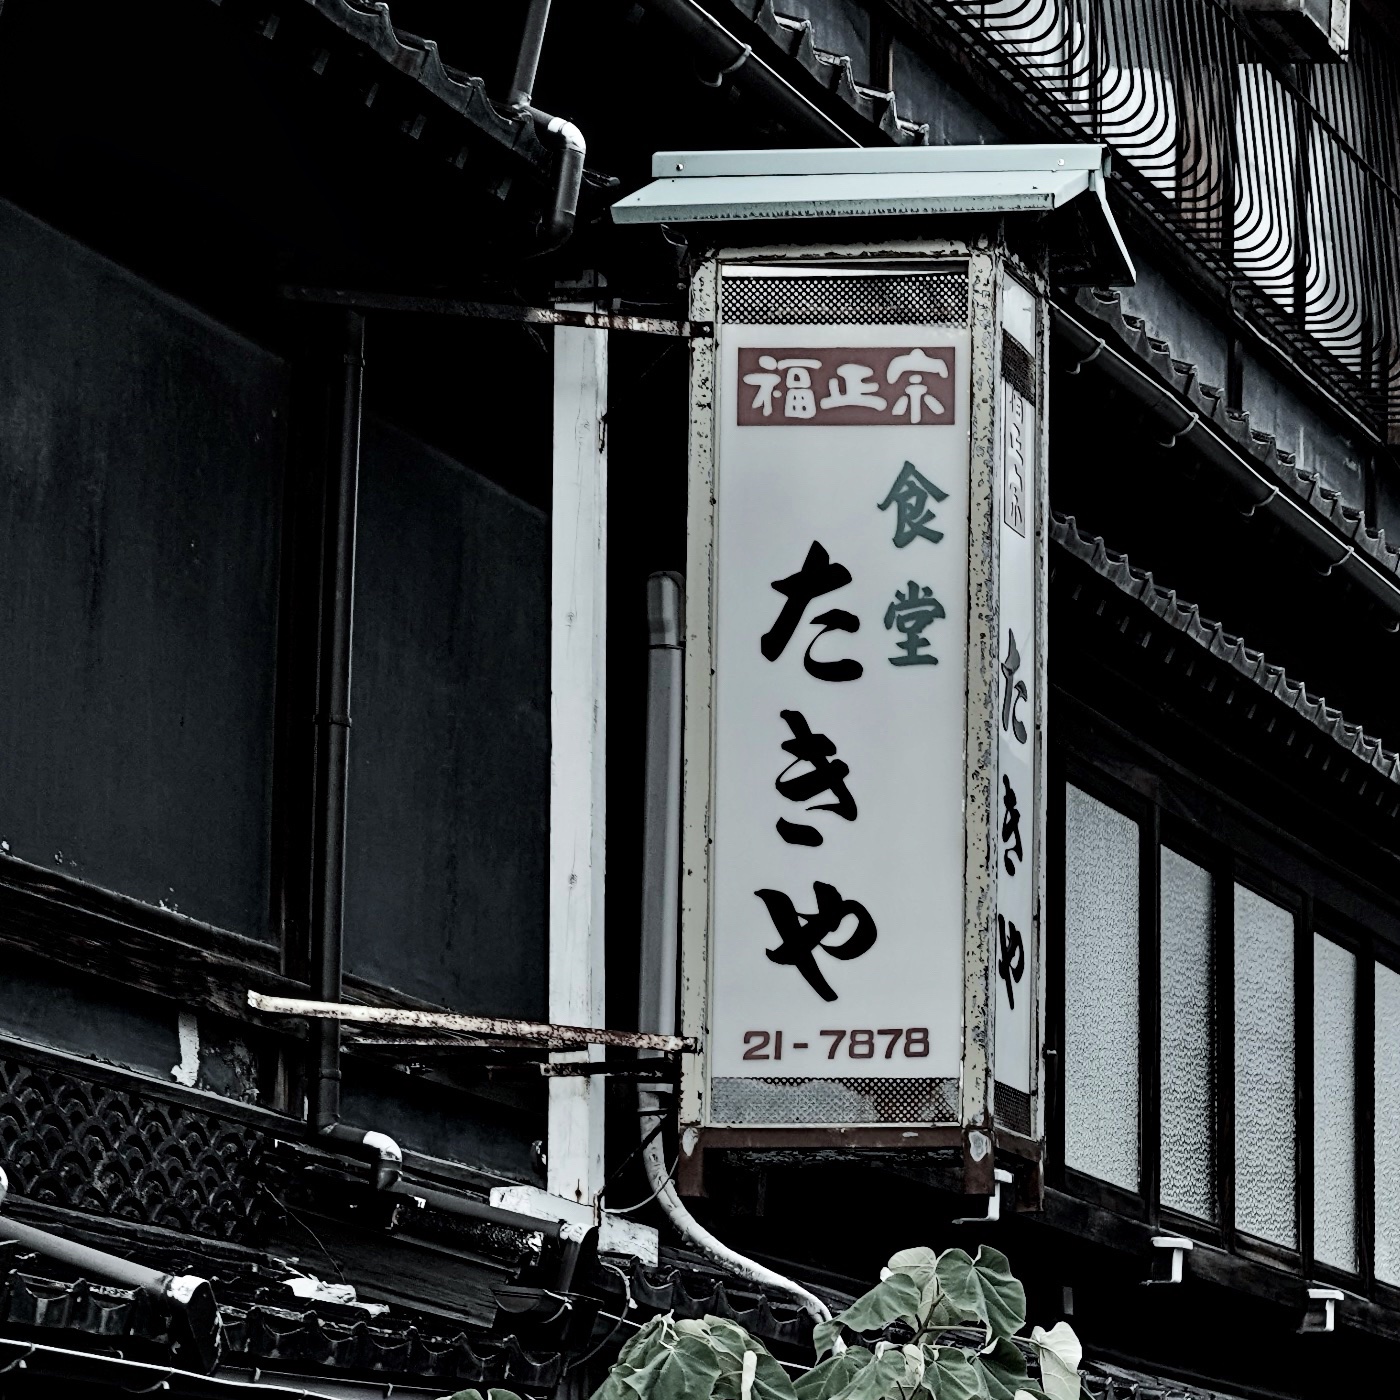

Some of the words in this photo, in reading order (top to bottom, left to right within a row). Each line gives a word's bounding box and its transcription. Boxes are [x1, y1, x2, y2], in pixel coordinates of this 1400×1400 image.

[742, 348, 949, 424] 福正宗
[877, 460, 950, 666] 食堂
[754, 540, 878, 1002] たきや
[998, 628, 1028, 1010] たきや
[742, 1027, 930, 1060] 21-7878
